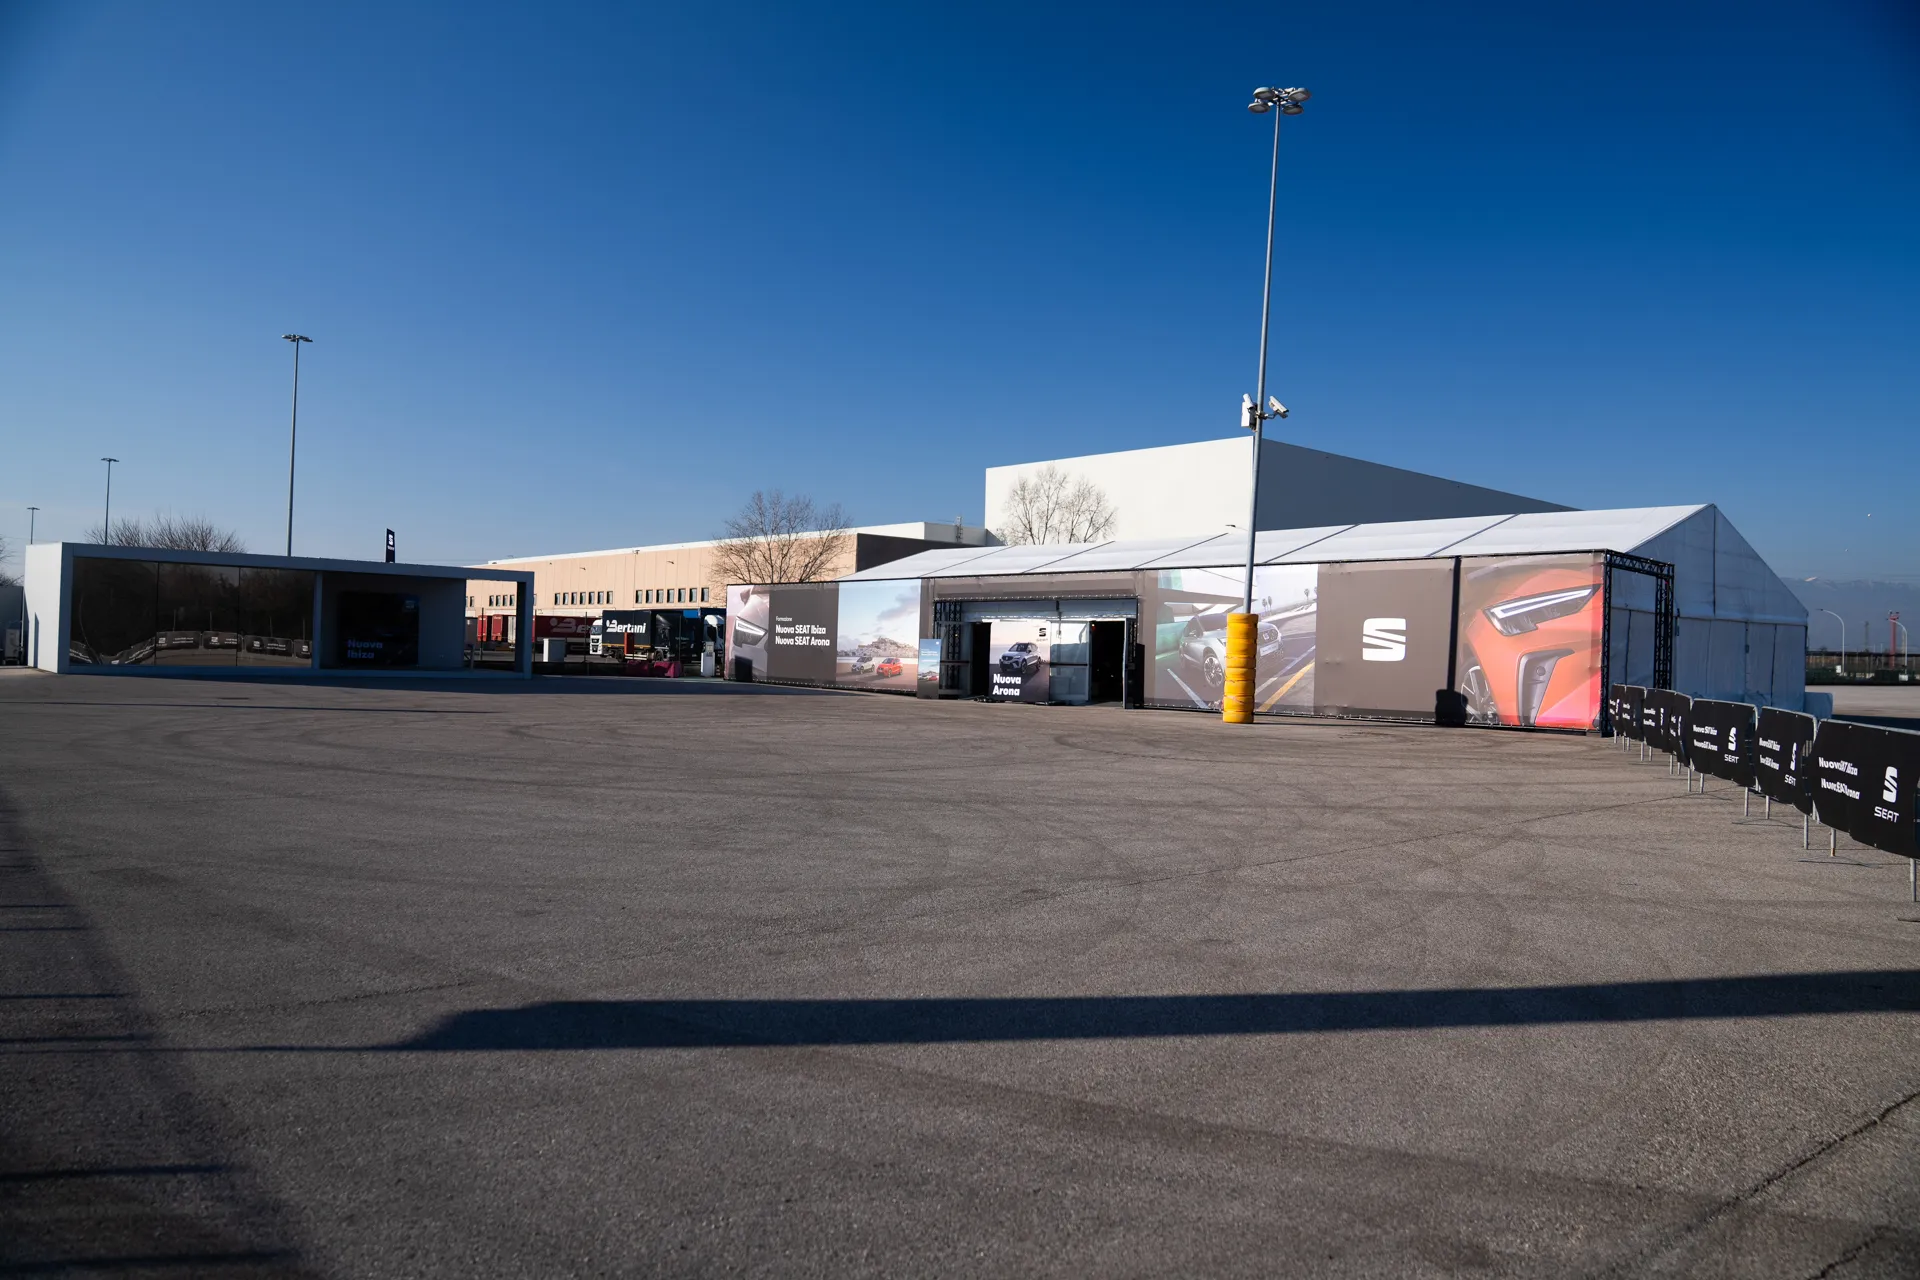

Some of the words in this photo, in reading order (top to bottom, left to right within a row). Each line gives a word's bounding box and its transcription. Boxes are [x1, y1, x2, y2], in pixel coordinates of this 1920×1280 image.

[605, 618, 647, 634] Bertani
[775, 624, 795, 634] Nuova
[795, 624, 811, 635] SEAT
[347, 639, 383, 649] Nuova
[775, 635, 795, 646] Nuova
[794, 636, 811, 646] SEAT
[810, 636, 831, 647] Arona
[347, 649, 375, 659] Ibiza
[993, 673, 1022, 685] Nuova
[992, 685, 1021, 696] Arona
[1724, 754, 1739, 763] SEAT
[1873, 806, 1900, 823] SEAT
